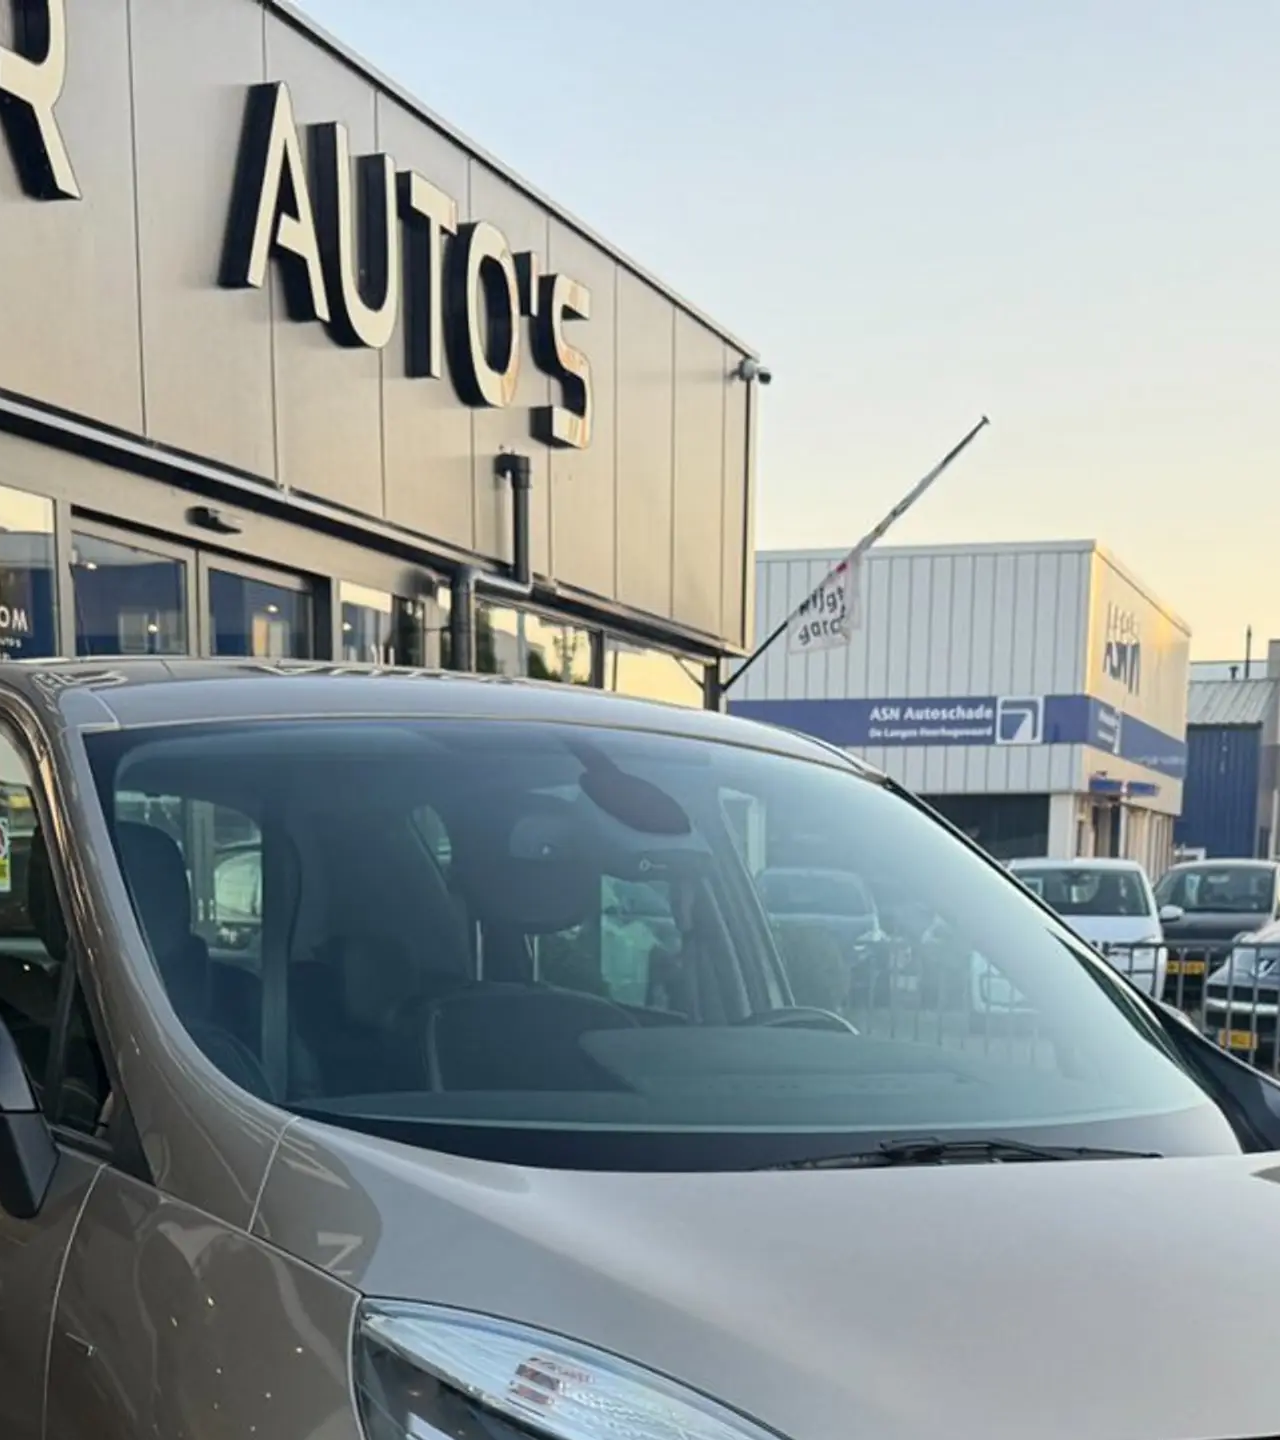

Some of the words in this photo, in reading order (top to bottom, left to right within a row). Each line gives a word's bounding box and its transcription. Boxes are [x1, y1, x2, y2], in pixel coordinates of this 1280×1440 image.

[223, 80, 593, 449] AUTO'S
[869, 706, 900, 722] ASN
[904, 704, 994, 722] Autoschade
